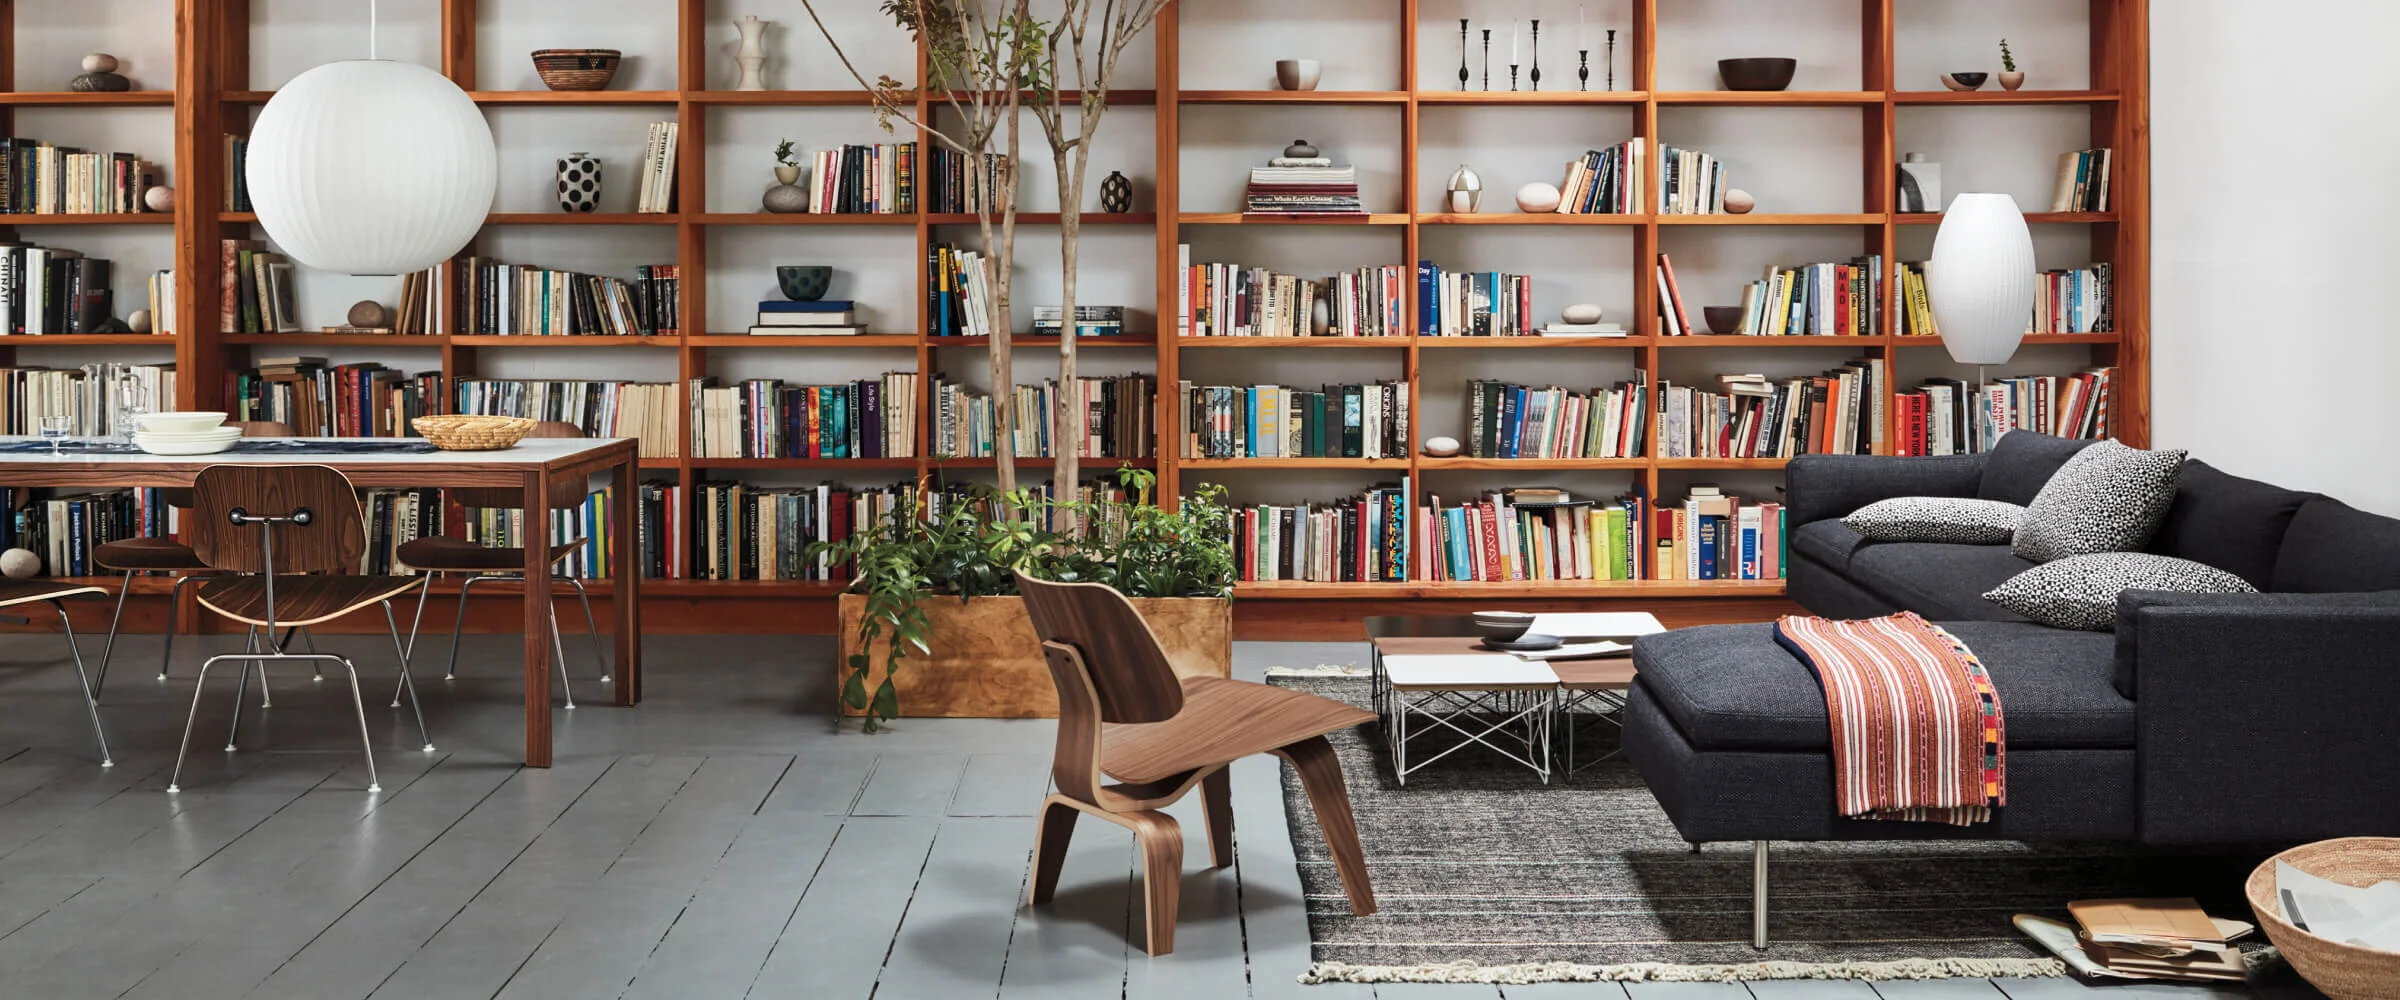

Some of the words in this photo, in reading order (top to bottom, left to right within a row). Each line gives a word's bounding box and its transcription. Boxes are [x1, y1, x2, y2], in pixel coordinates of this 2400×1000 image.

[0, 256, 9, 303] CHINATI
[1916, 289, 1926, 310] Birds
[867, 396, 875, 412] Style
[1382, 387, 1391, 418] ORIGINS
[1911, 396, 1921, 415] HERE
[1911, 423, 1921, 438] NEW
[1911, 439, 1921, 457] YORK
[409, 494, 417, 506] EL
[718, 490, 726, 503] Art
[73, 511, 81, 538] Jackson
[1676, 512, 1684, 541] ORIGINS
[74, 538, 82, 561] Pollock
[718, 536, 726, 577] Architecture
